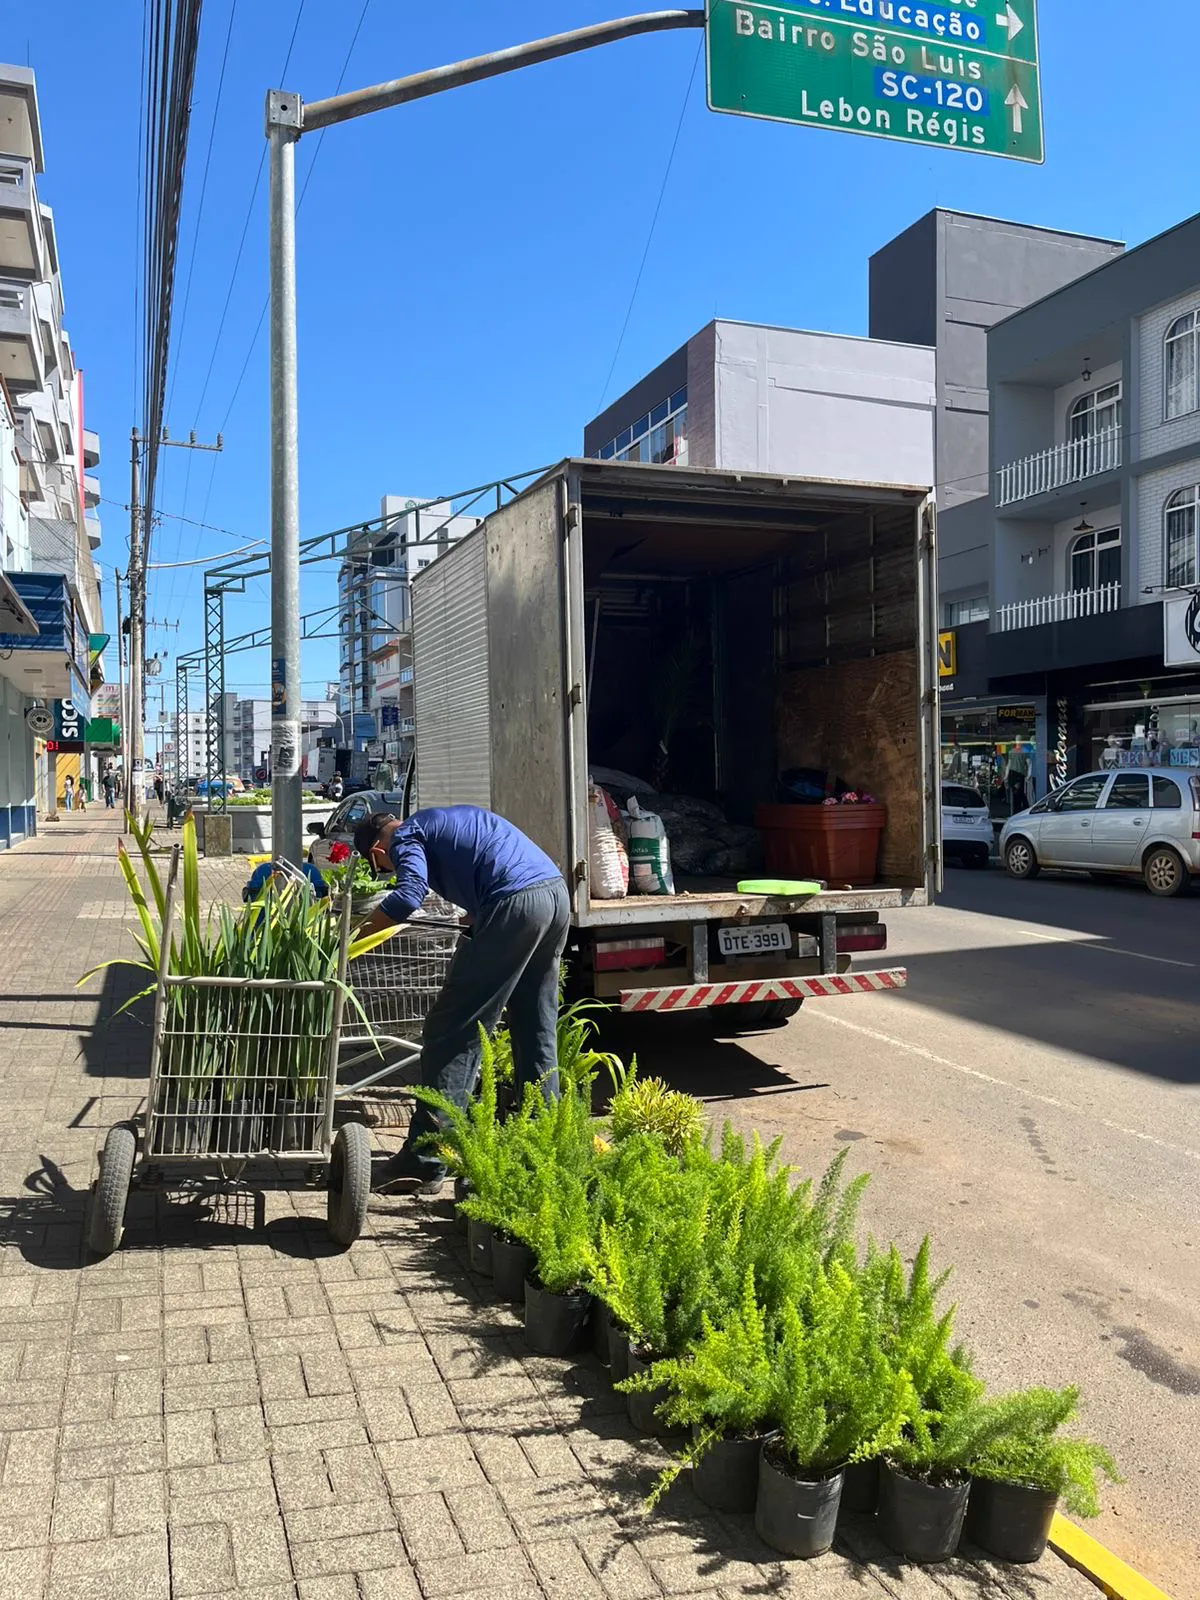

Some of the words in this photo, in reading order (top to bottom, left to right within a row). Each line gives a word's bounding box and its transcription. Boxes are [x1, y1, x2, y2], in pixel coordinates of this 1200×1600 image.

[735, 7, 836, 51] Bairro
[851, 31, 906, 65] São
[920, 46, 983, 80] Luis
[801, 89, 891, 129] Lebon
[906, 108, 985, 146] Régis
[882, 71, 983, 112] SC-120
